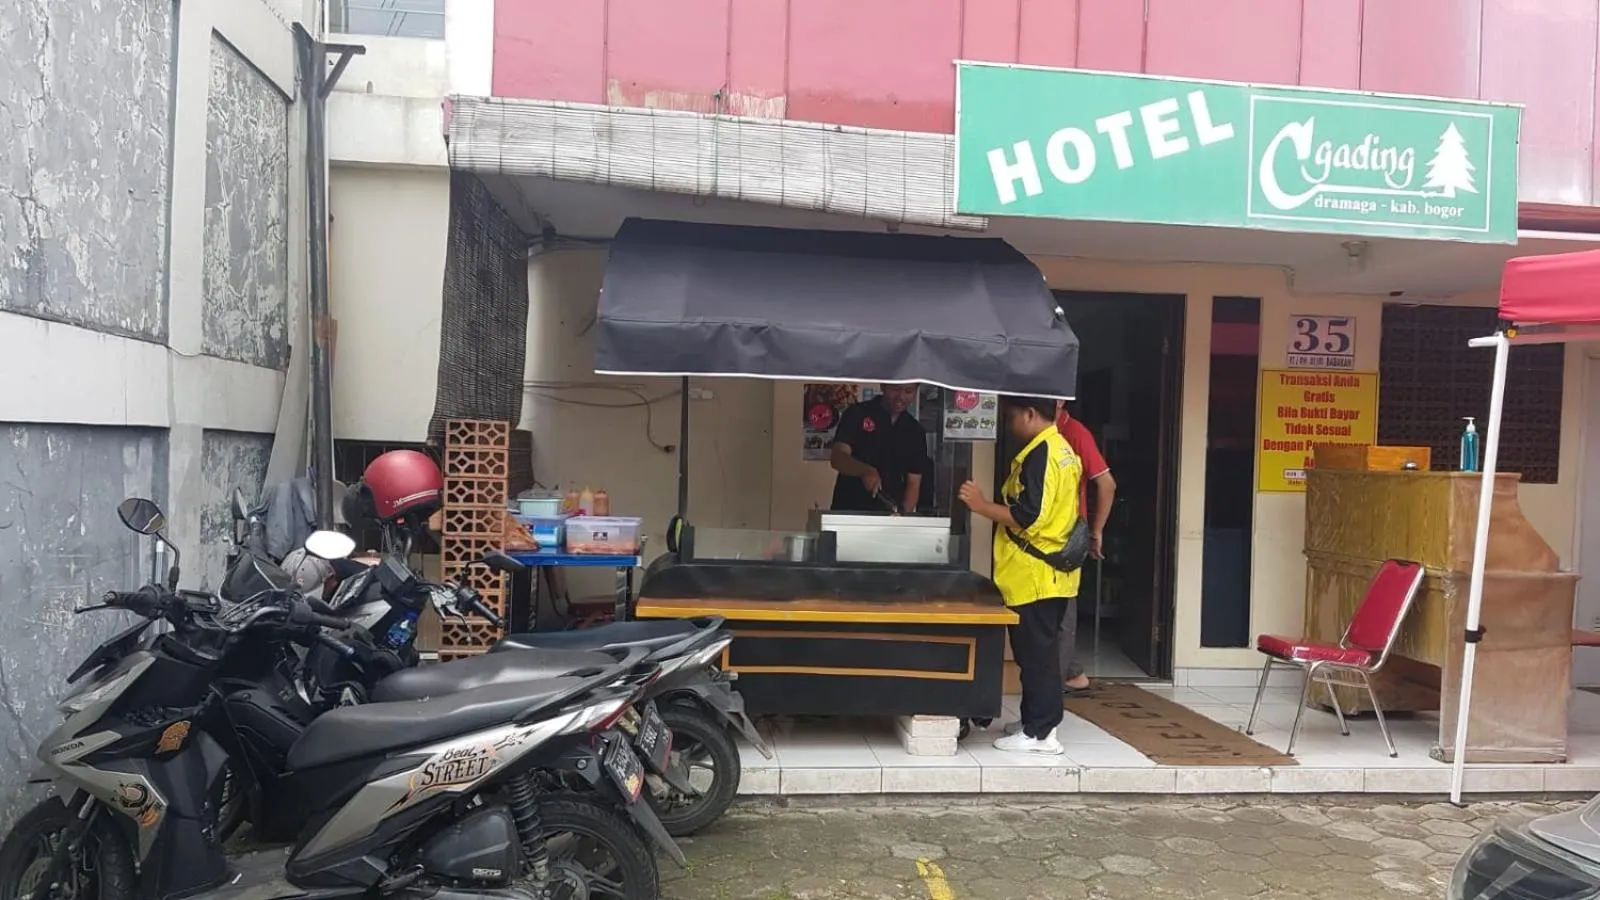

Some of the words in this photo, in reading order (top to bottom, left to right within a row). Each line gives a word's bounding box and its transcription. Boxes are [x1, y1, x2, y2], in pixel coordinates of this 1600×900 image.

[987, 90, 1234, 204] HOTEL
[1315, 195, 1376, 214] dramaga
[1390, 198, 1420, 214] kab.
[1424, 202, 1465, 218] bogor
[1293, 318, 1350, 353] 35
[1279, 373, 1331, 387] Transaksi
[1333, 375, 1360, 387] Anda
[1303, 391, 1336, 403] Gratis
[1277, 406, 1298, 418] Bila
[1300, 407, 1328, 419] Bukti
[1329, 408, 1361, 421] Bayar
[1285, 423, 1313, 435] Tidak
[1315, 424, 1351, 436] Sesuai
[1263, 439, 1304, 452] Dengan
[421, 757, 488, 785] STREET
